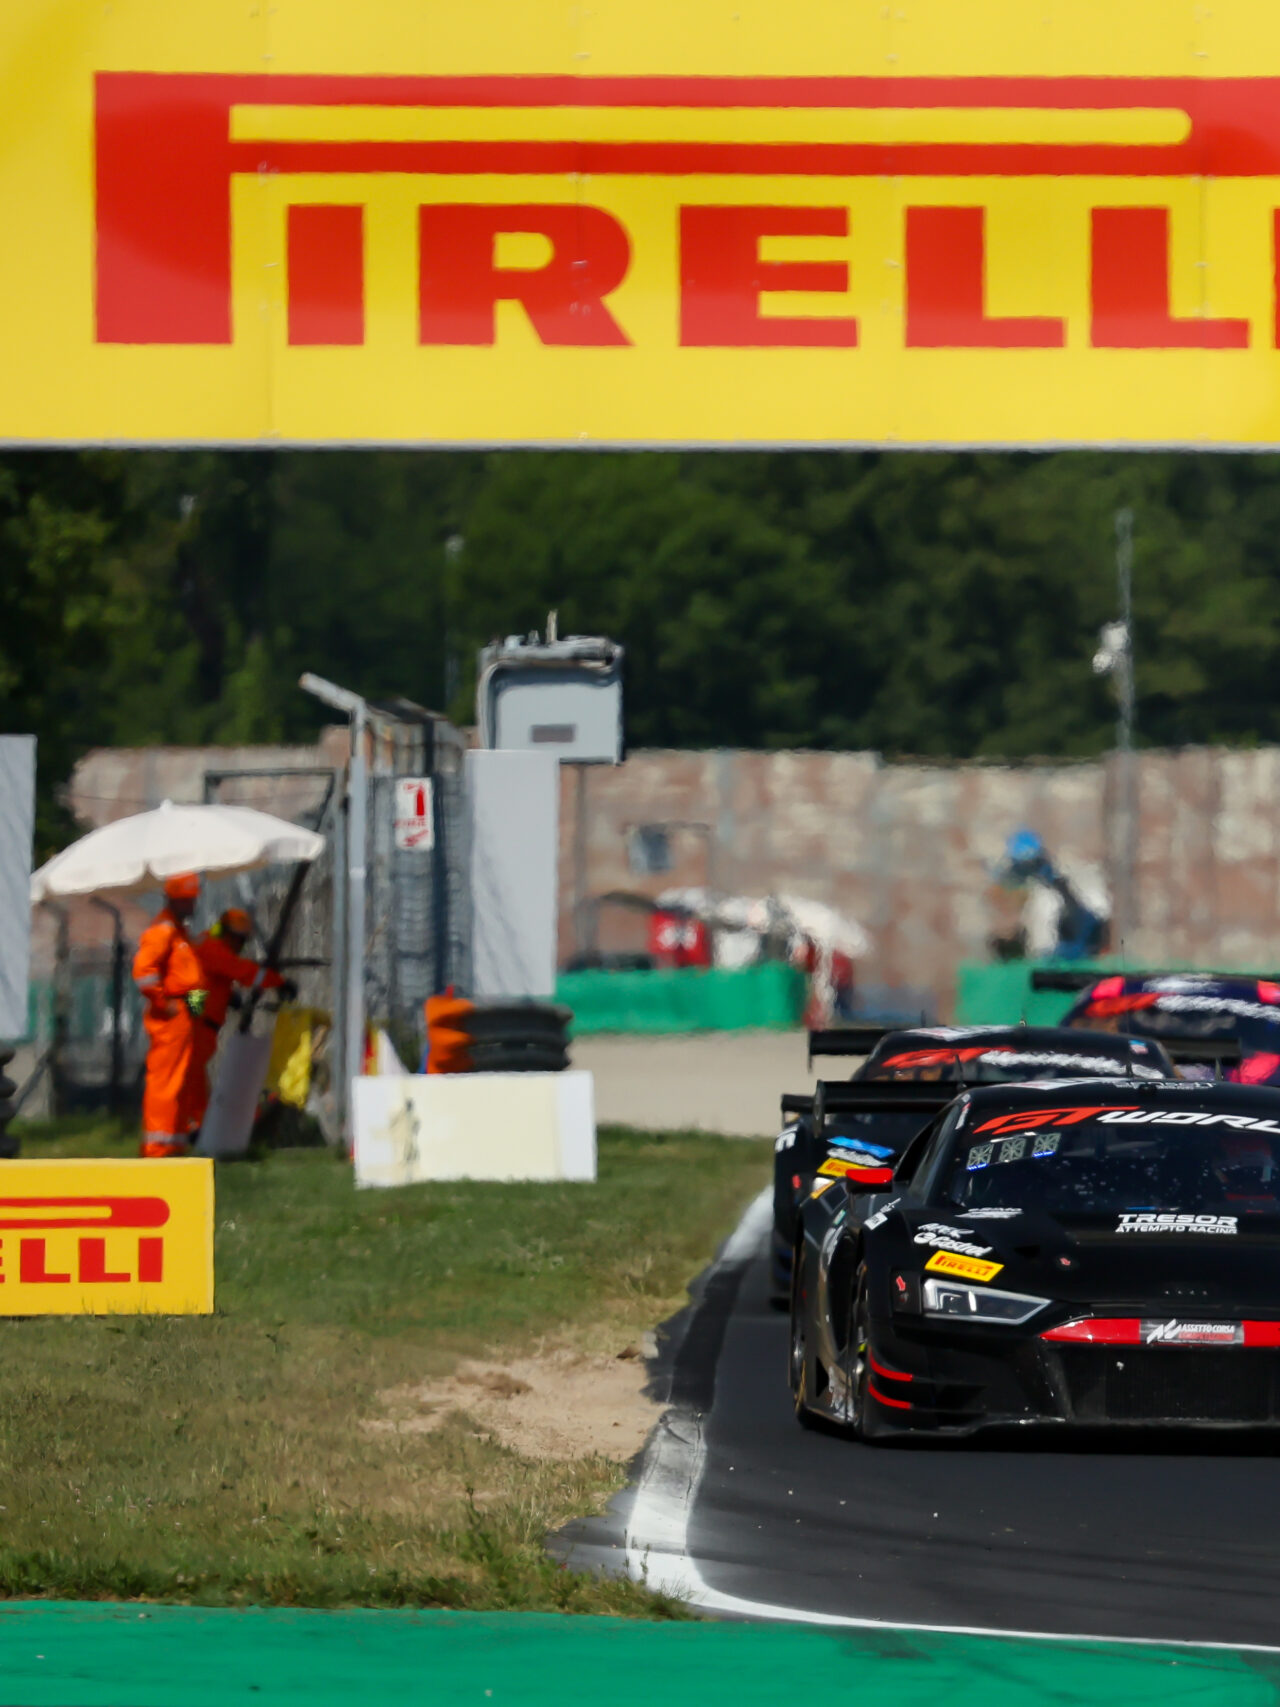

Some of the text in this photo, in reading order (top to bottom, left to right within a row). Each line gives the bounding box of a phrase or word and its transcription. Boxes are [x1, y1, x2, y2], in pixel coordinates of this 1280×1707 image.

[1118, 1213, 1238, 1227] TRESOR
[1115, 1224, 1238, 1234] ATTEMPTO RACING
[934, 1255, 994, 1277] PIRELLI
[1180, 1323, 1235, 1334] ASSETTO CORSA
